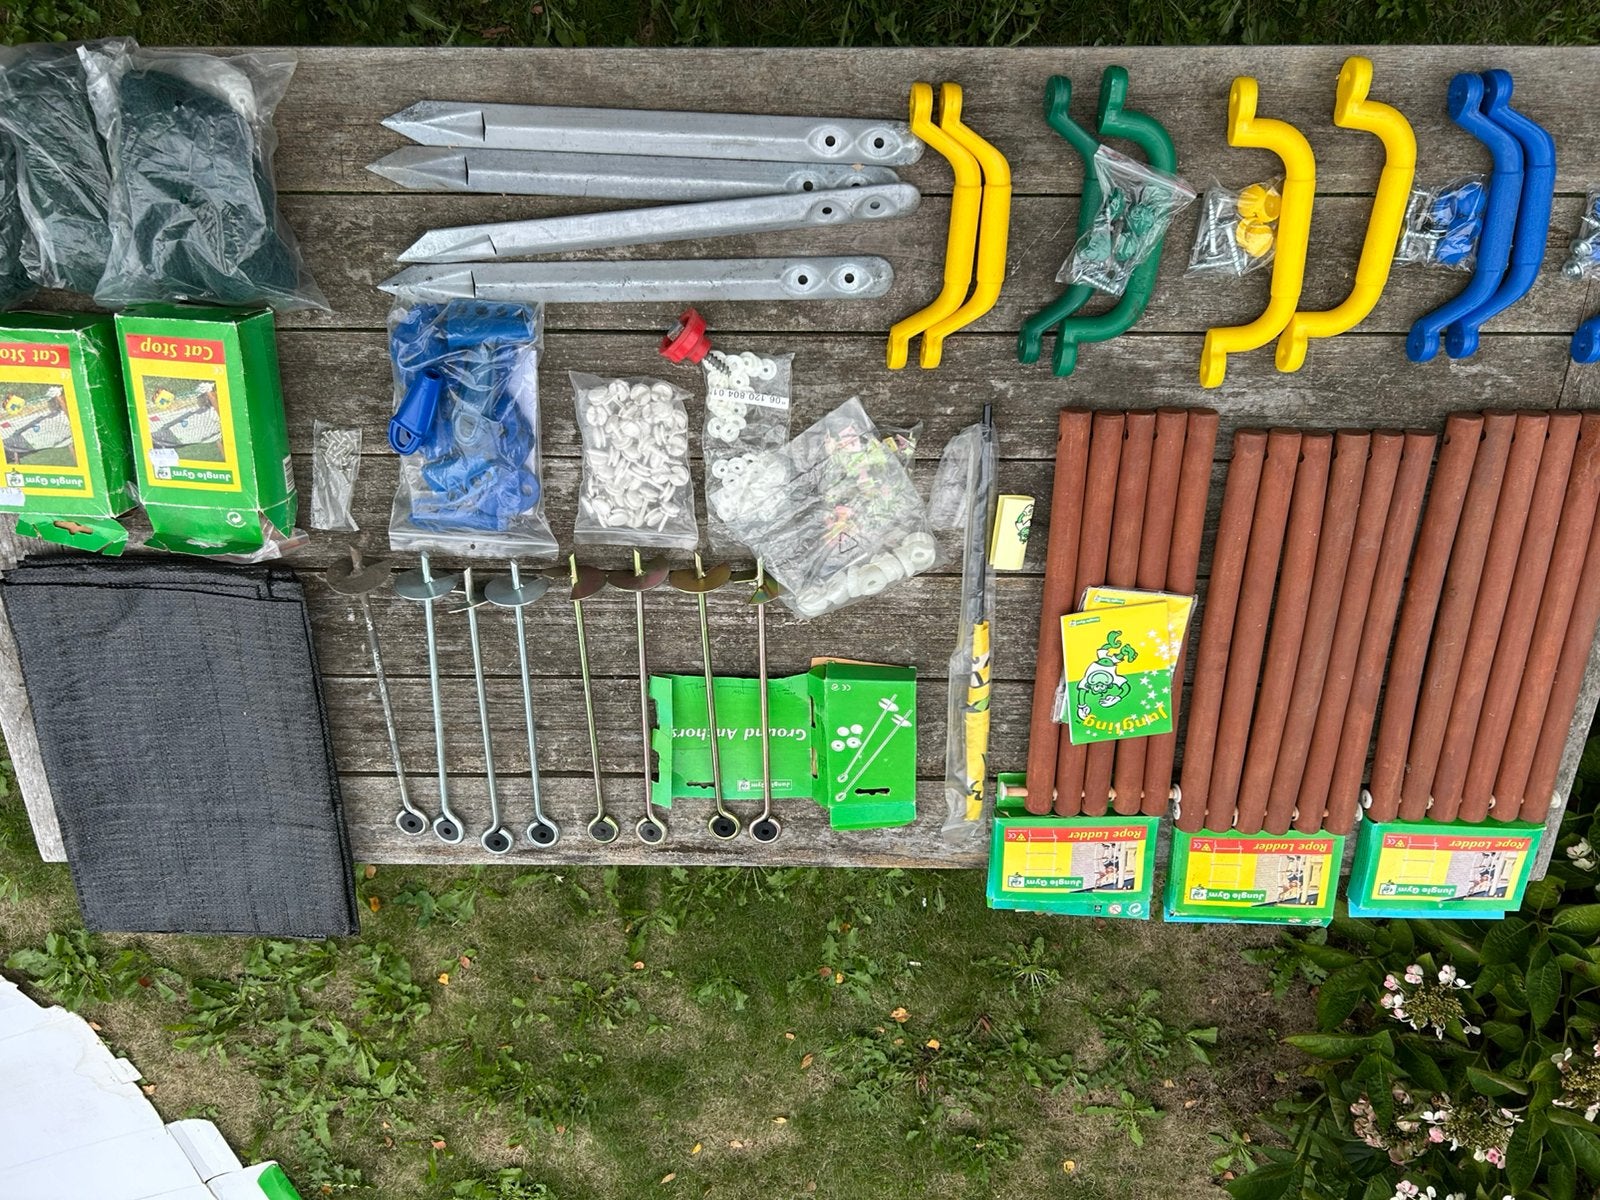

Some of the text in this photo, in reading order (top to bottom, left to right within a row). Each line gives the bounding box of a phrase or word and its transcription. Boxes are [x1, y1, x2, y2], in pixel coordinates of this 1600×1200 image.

[140, 337, 214, 361] Cat Stop
[0, 348, 60, 365] Cat Sto
[728, 390, 746, 400] 804
[748, 393, 765, 402] 120
[25, 475, 84, 487] Jungle Gym
[171, 469, 232, 482] Jungle Gym
[1083, 703, 1168, 735] Jungling
[671, 728, 738, 741] Anhors
[1067, 828, 1142, 841] Rope Ladder
[1252, 841, 1328, 852] Rope Ladder
[1448, 839, 1526, 850] Rope Ladder
[1025, 877, 1083, 887] Jungle Gym
[1207, 890, 1265, 900] Jungle Gym
[1396, 885, 1456, 895] Jungle Gym
